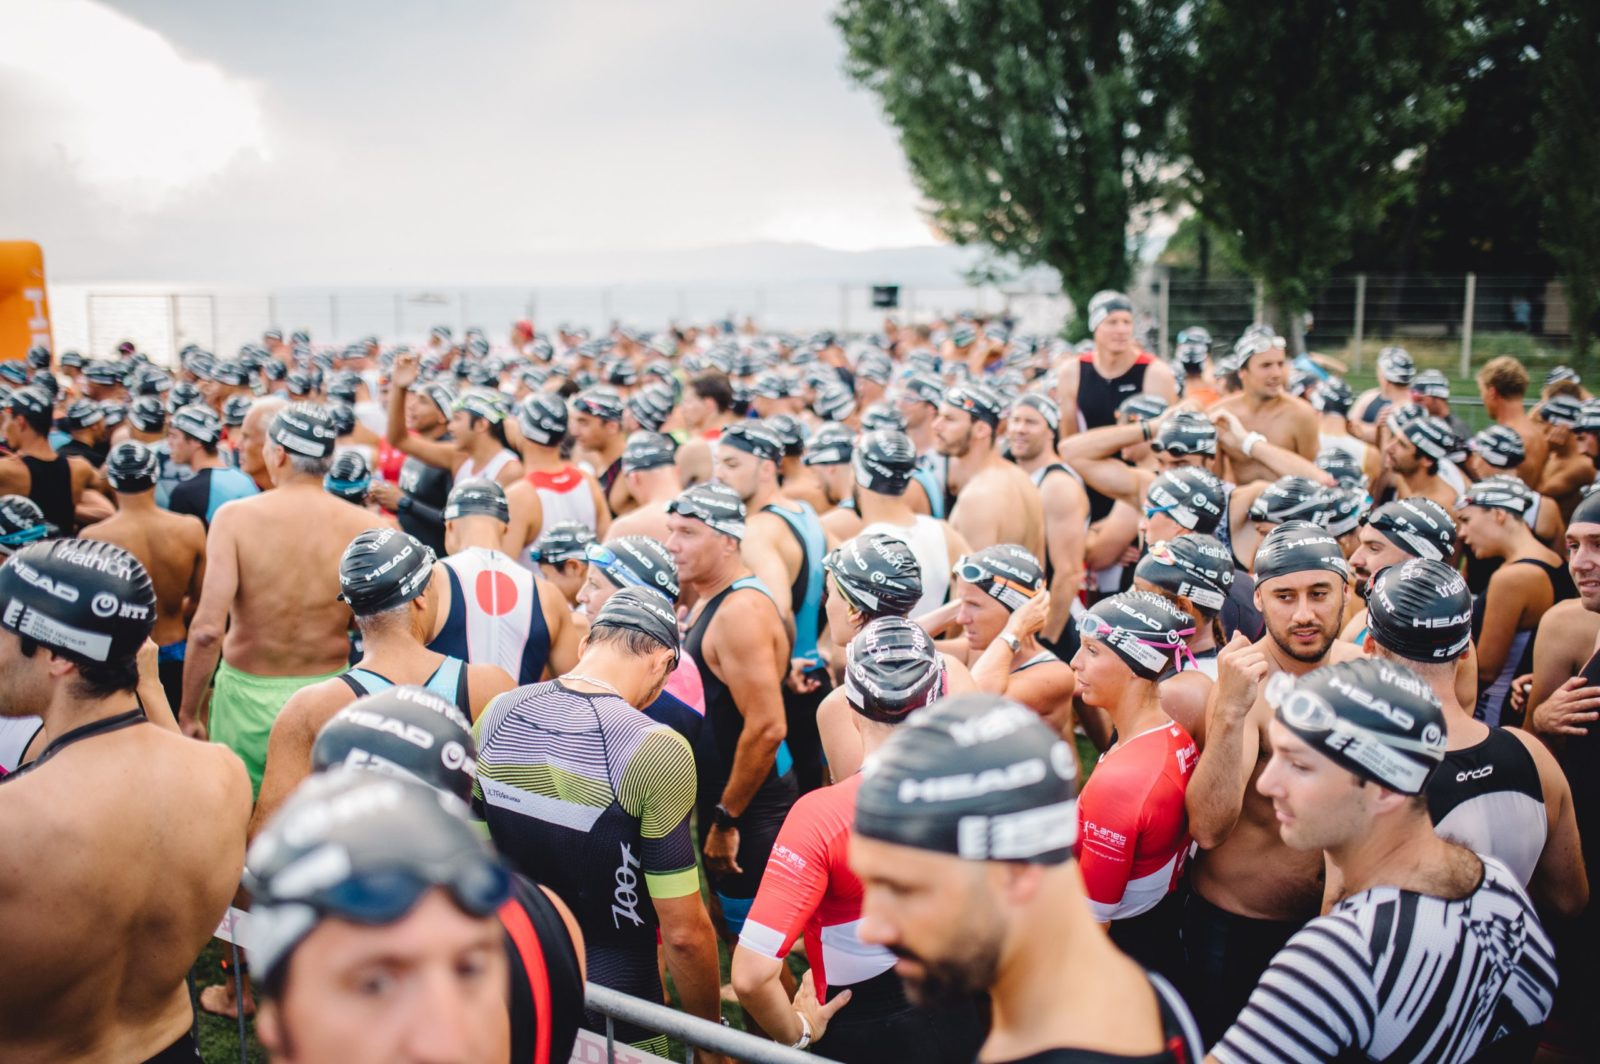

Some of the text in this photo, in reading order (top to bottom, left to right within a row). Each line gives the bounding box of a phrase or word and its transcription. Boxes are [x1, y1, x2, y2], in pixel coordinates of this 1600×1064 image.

[56, 546, 133, 581] triathlon
[364, 545, 413, 582] HEAD
[982, 556, 1033, 583] HEAD
[9, 557, 80, 603] HEAD
[119, 603, 149, 620] NTT
[1109, 599, 1163, 631] HEAD
[1143, 593, 1189, 625] triathlon
[1412, 609, 1471, 629] HEAD
[1328, 676, 1415, 731] HEAD
[337, 710, 435, 750] HEAD
[1456, 763, 1494, 783] orca
